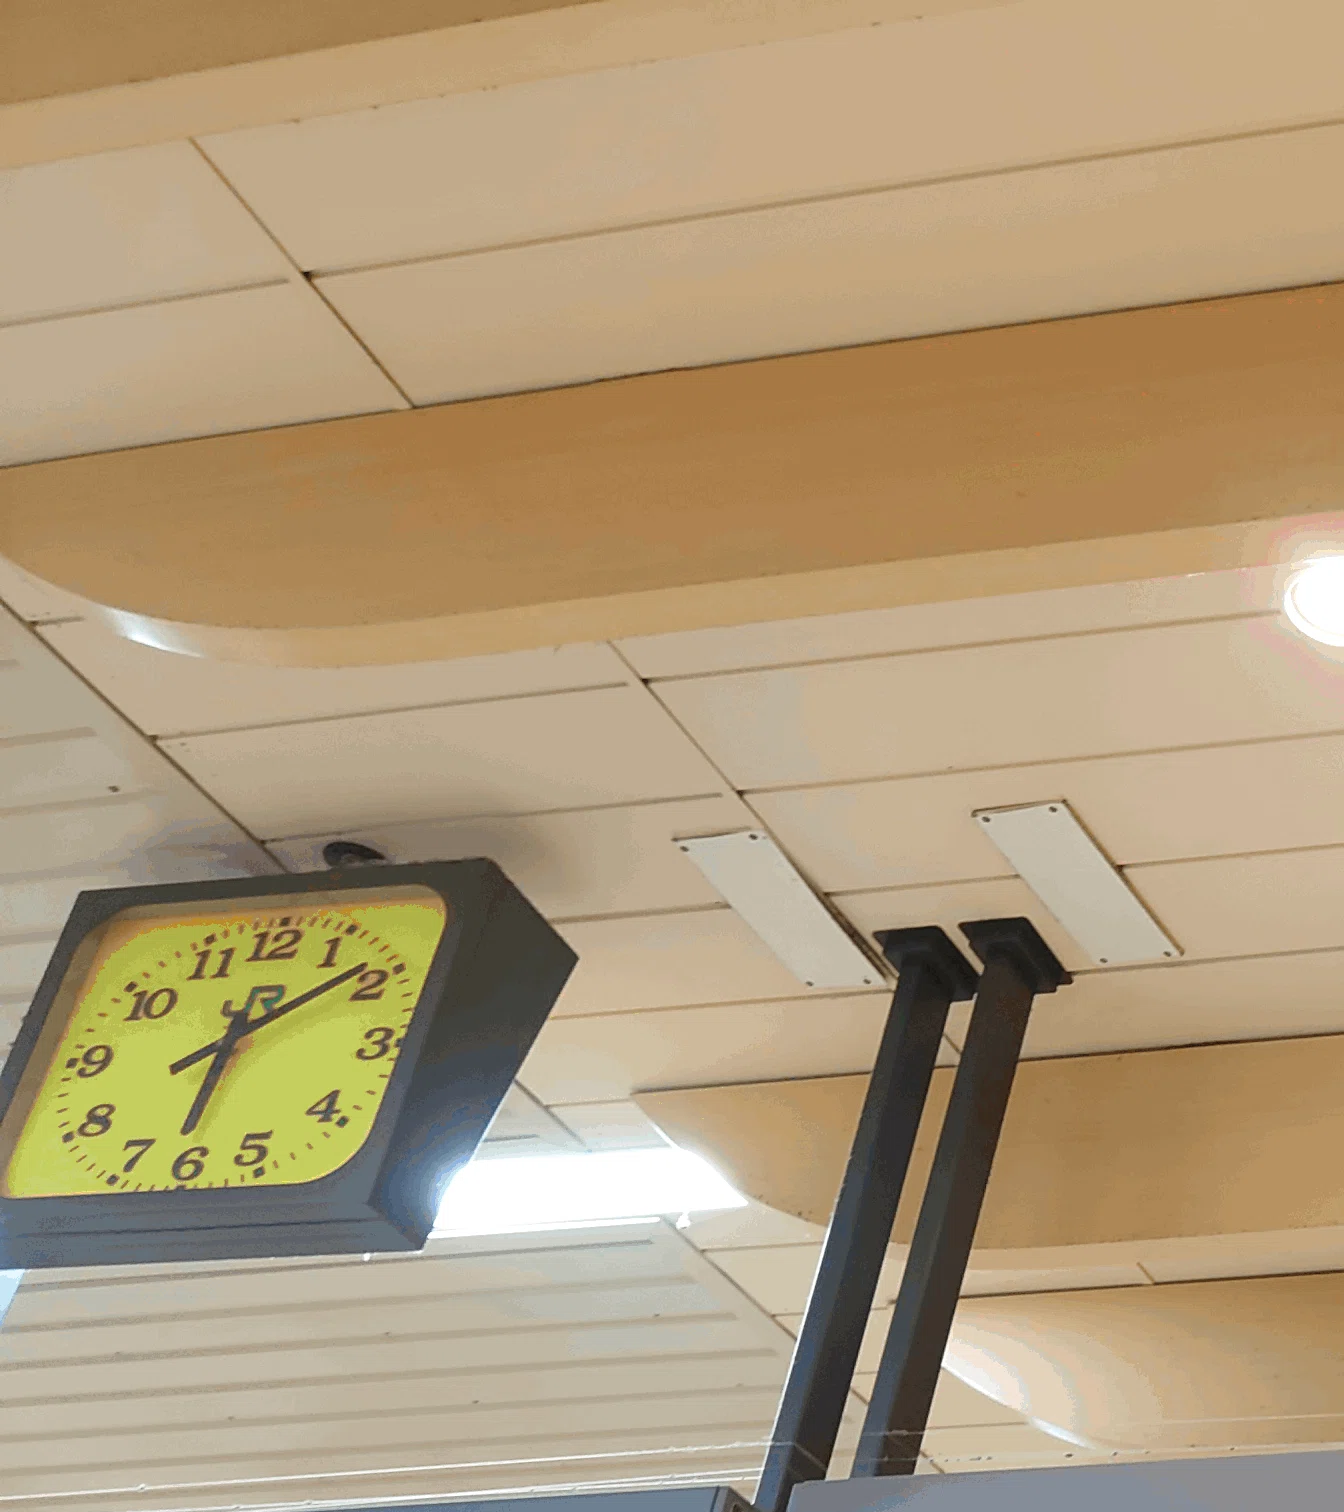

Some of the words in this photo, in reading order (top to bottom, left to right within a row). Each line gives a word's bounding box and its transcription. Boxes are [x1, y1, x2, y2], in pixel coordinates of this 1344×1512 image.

[245, 929, 302, 962] 12
[316, 937, 340, 968] 1
[186, 946, 236, 980] 11
[349, 968, 389, 1001] 2
[123, 987, 179, 1021] 10
[355, 1027, 394, 1059] 3
[77, 1044, 114, 1077] 9
[77, 1103, 116, 1136] 8
[304, 1089, 340, 1121] 4
[121, 1139, 156, 1172] 7
[171, 1147, 209, 1181] 6
[233, 1130, 273, 1166] 5
